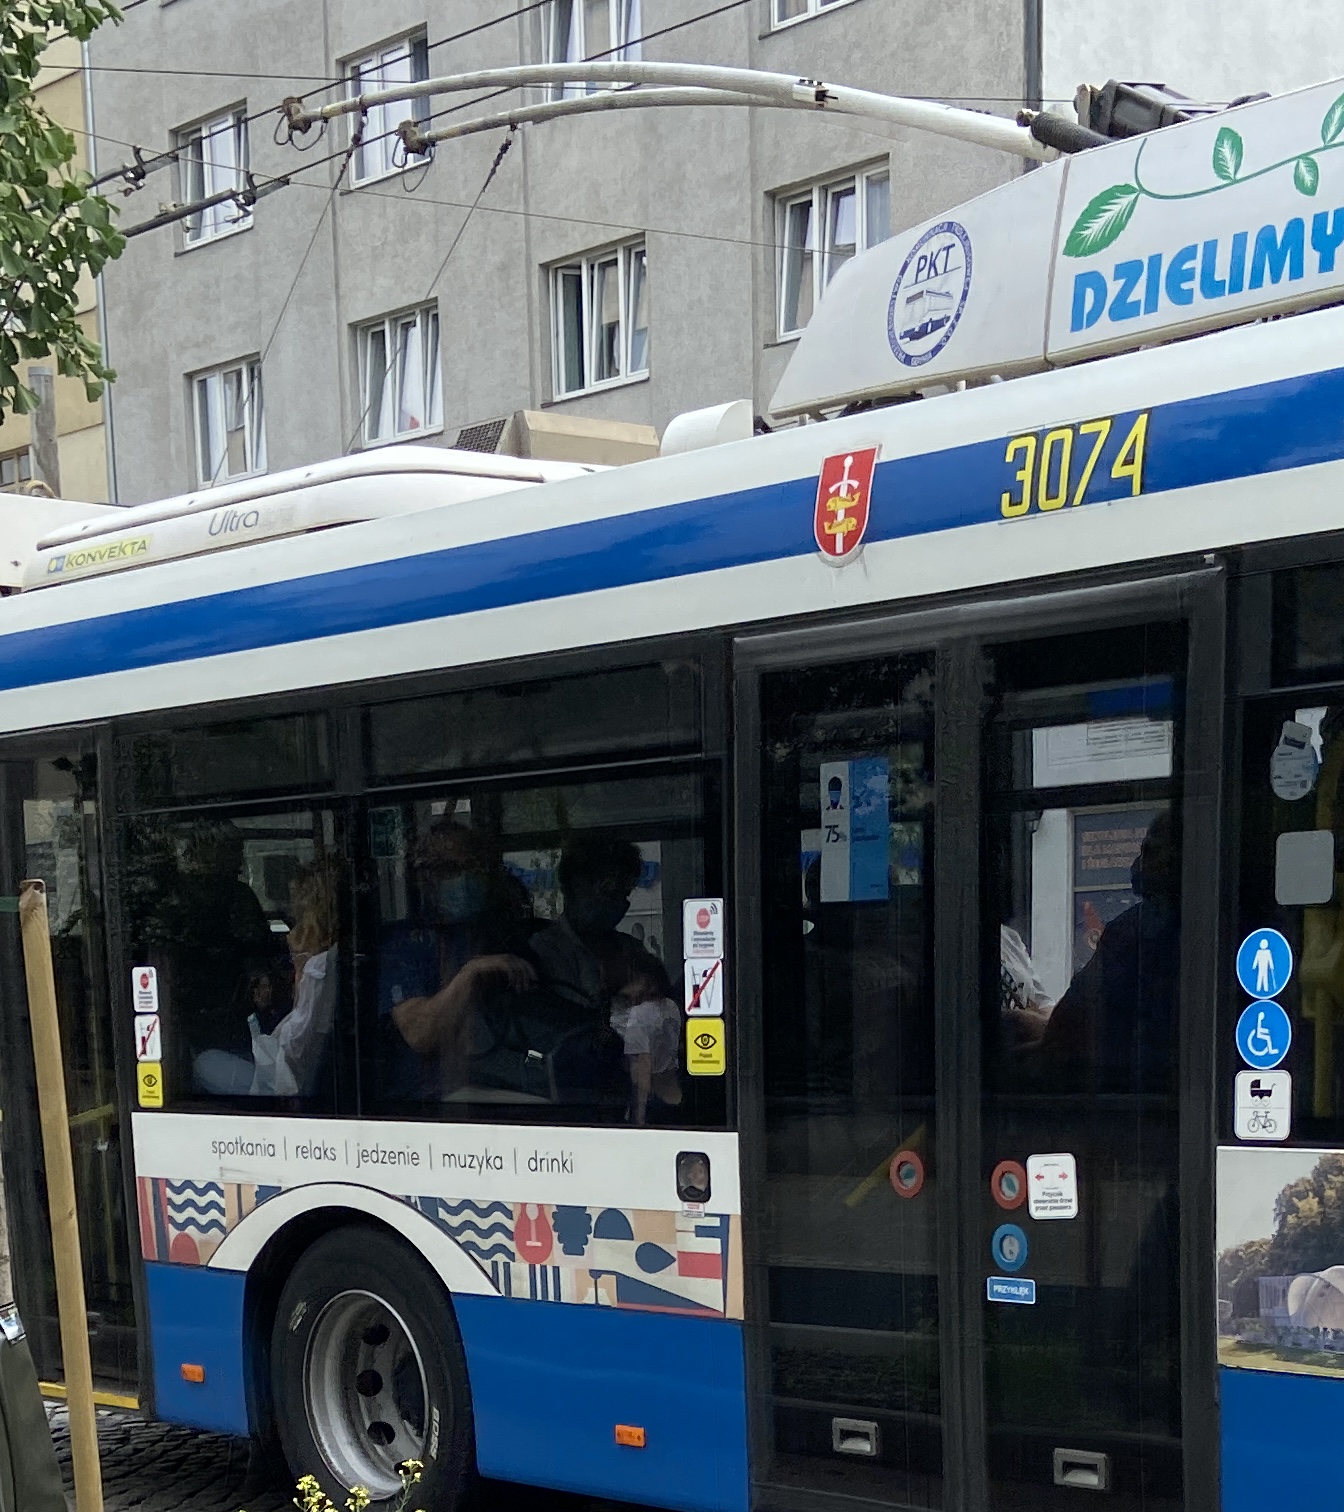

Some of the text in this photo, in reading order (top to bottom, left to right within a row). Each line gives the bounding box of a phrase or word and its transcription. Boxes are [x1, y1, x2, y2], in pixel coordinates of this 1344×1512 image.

[915, 243, 956, 284] PKT
[1000, 413, 1149, 518] 3074
[208, 509, 260, 536] Ultra
[65, 538, 148, 569] KONVEKTA
[211, 1135, 276, 1160] spotkania
[295, 1138, 337, 1161] relaks
[356, 1142, 420, 1169] jedzenie
[441, 1147, 504, 1176] muzyka
[527, 1149, 574, 1174] drinki
